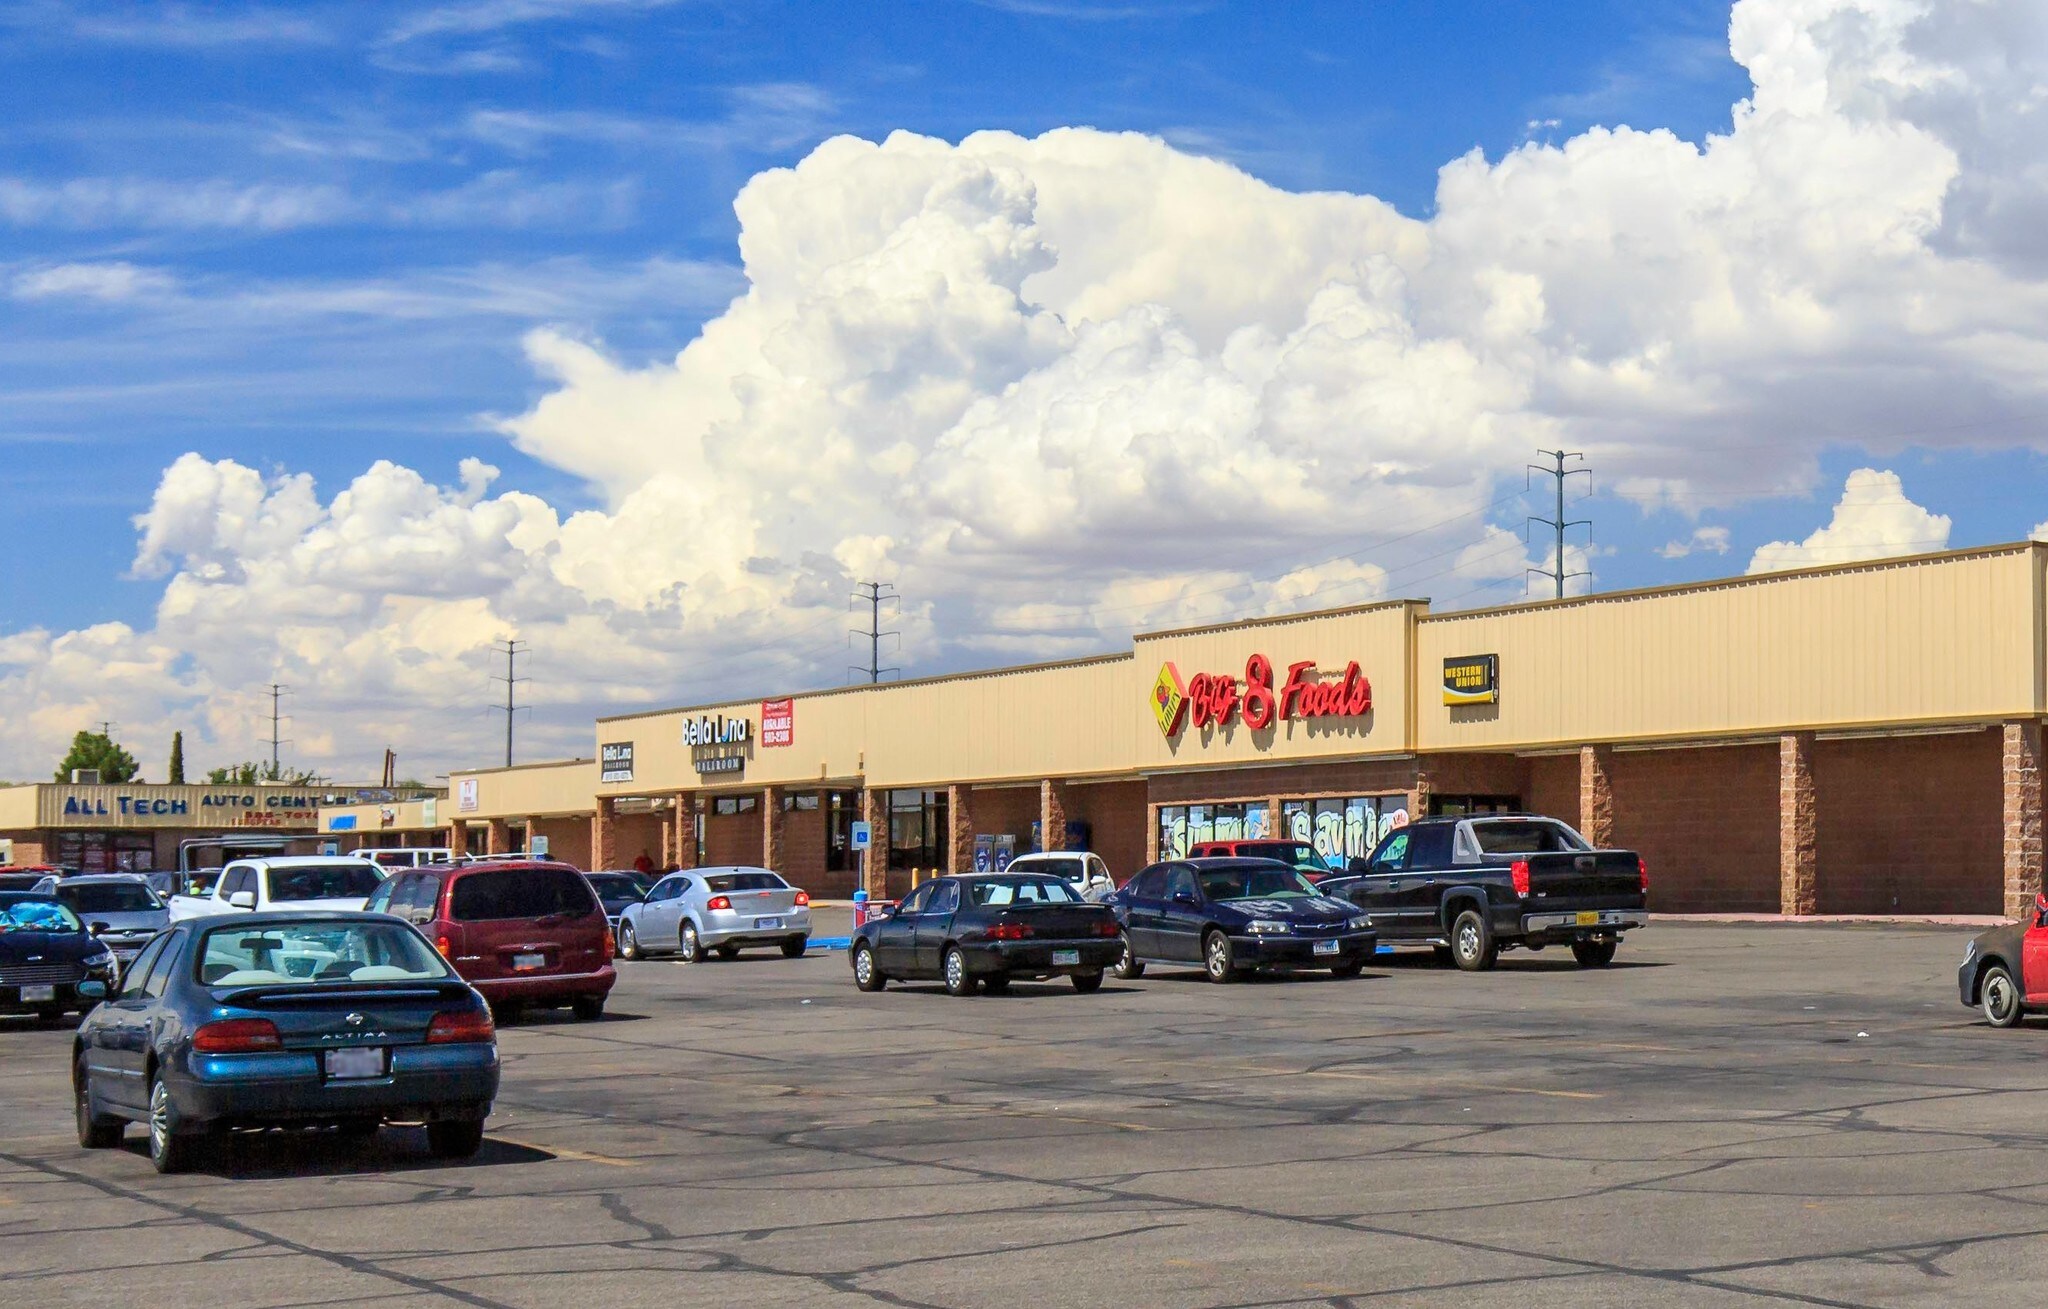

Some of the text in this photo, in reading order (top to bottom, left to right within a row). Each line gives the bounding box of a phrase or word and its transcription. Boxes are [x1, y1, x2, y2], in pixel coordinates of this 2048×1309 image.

[1445, 665, 1481, 679] WESTERN
[1456, 676, 1481, 688] UNION
[1243, 653, 1275, 729] 8
[1279, 659, 1373, 720] Foods
[682, 714, 747, 746] Bella Luna
[696, 758, 740, 772] BALLROOM
[64, 796, 109, 815] ALL
[116, 796, 188, 815] TECH
[201, 794, 255, 807] AUTO
[321, 1031, 387, 1040] ALTIMA
